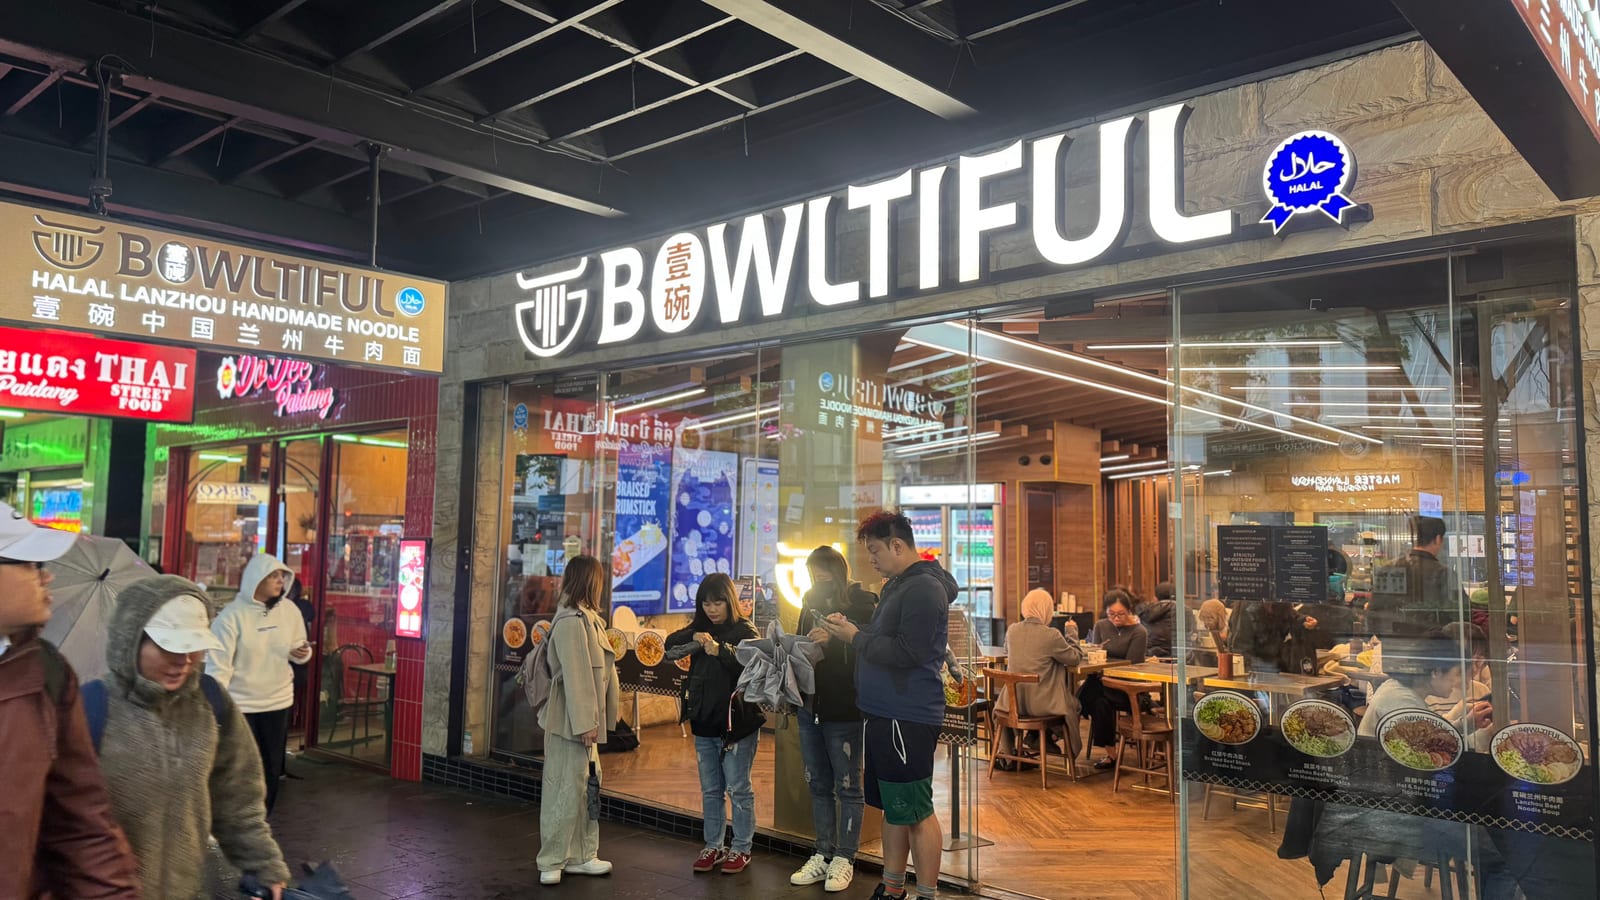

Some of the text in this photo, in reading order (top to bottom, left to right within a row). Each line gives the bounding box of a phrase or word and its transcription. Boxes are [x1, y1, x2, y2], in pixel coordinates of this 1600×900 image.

[1280, 151, 1336, 182] حلال
[1289, 180, 1324, 194] HALAL
[597, 103, 1232, 344] BOWLTIFUL
[115, 231, 395, 318] BOWLTIFUL
[664, 241, 692, 323] 壹碗
[32, 270, 420, 343] HALAL LANZHOU HANDMADE NOODLE
[32, 295, 421, 366] 壹碗中国兰州牛肉面
[95, 351, 188, 390] THAI
[110, 384, 171, 401] STREET
[119, 398, 163, 412] FOOD
[616, 481, 650, 498] BRAISED
[1517, 804, 1541, 813] Noodle
